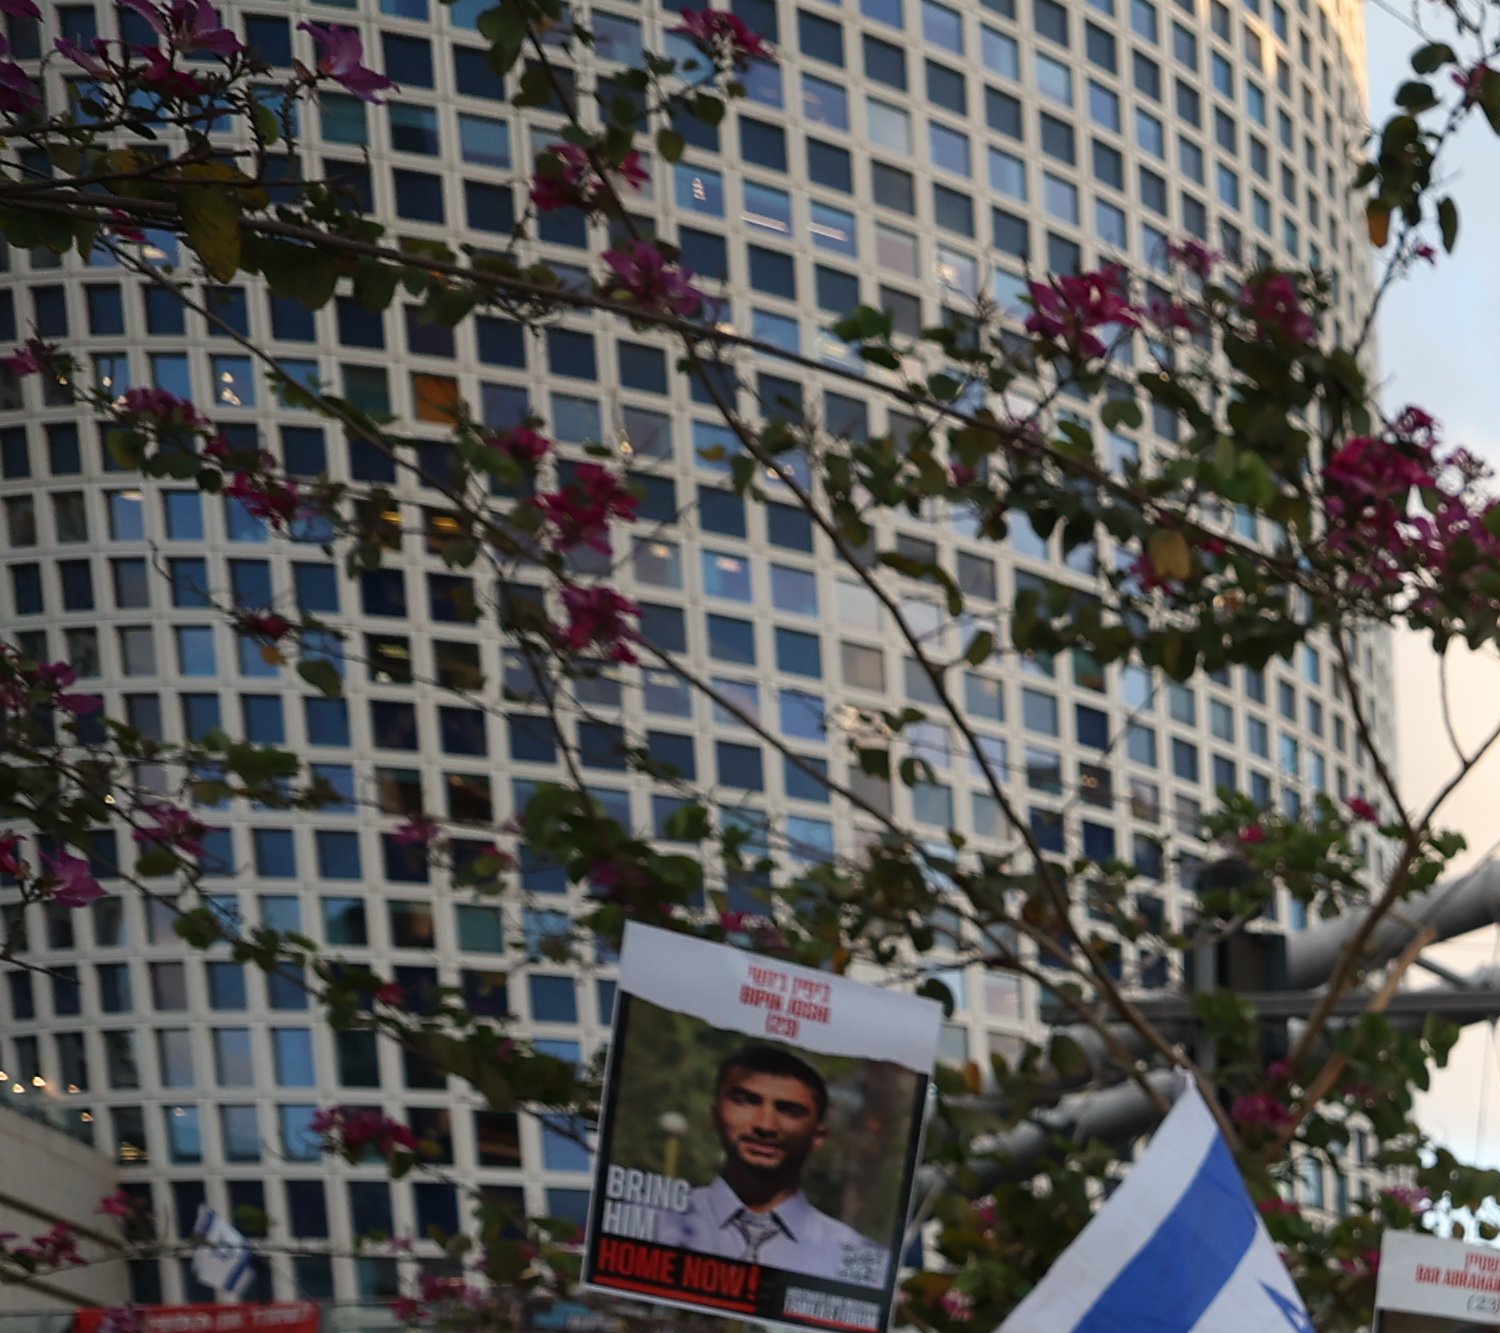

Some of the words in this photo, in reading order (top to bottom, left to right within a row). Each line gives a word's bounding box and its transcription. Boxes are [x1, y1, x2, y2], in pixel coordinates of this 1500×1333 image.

[607, 1164, 690, 1212] BRING
[602, 1200, 659, 1240] HIM
[599, 1238, 677, 1284] HOME
[682, 1255, 761, 1299] NOW!
